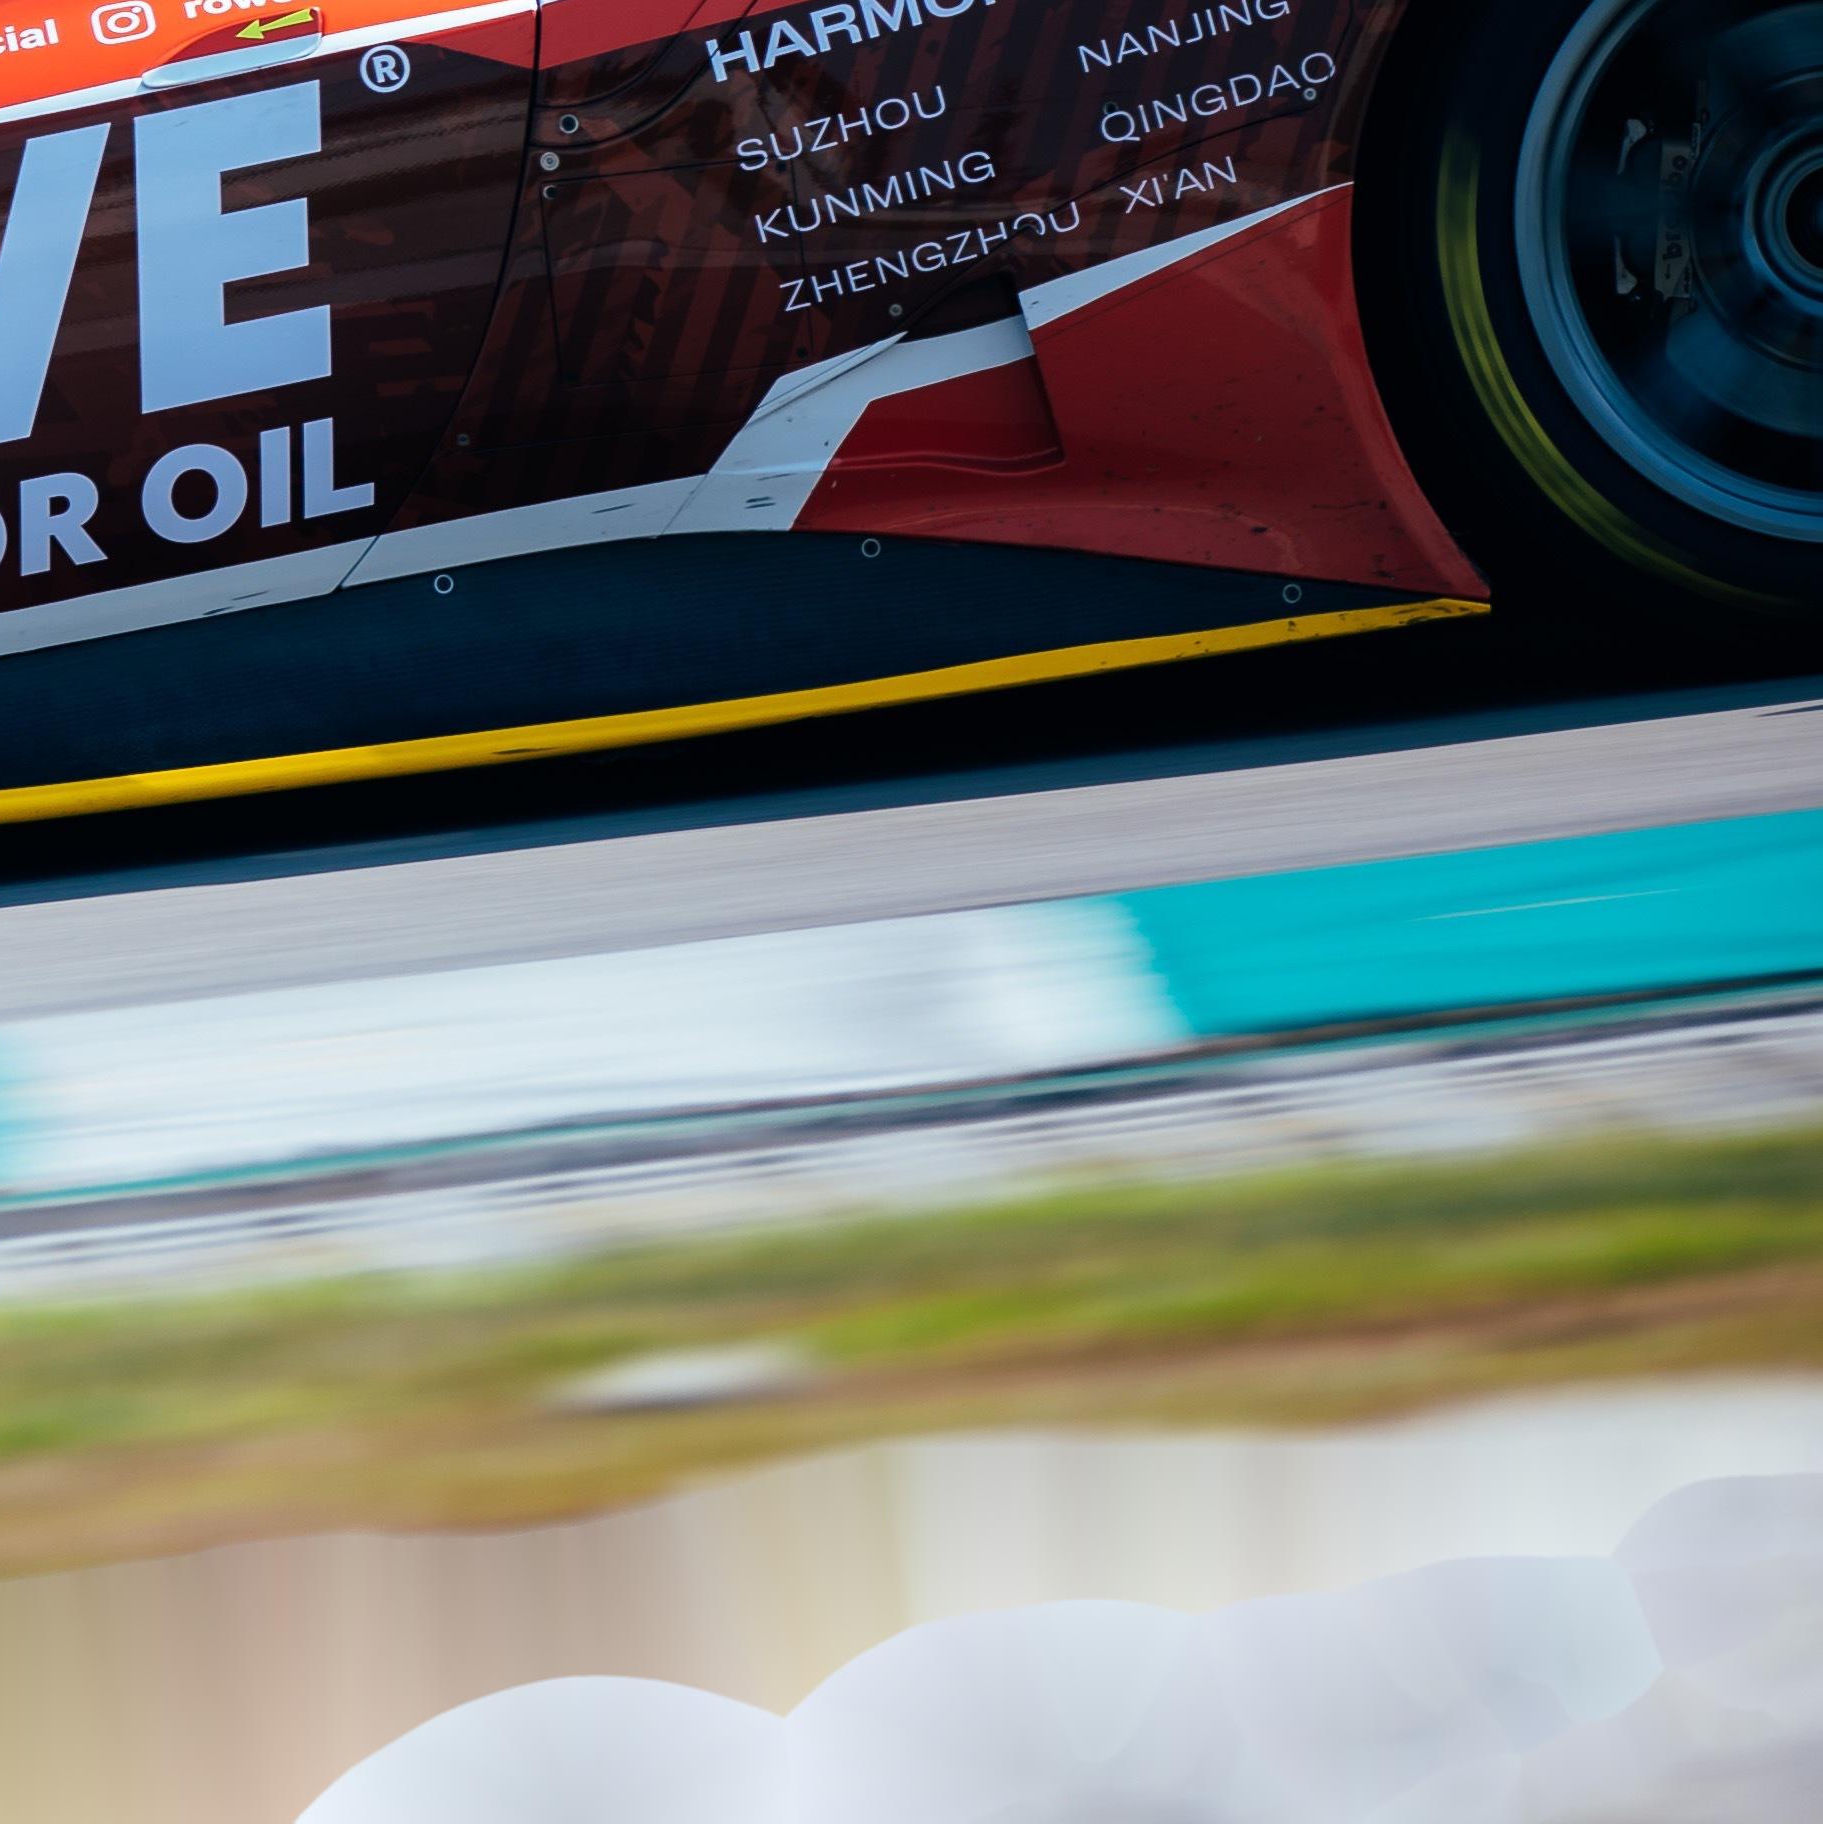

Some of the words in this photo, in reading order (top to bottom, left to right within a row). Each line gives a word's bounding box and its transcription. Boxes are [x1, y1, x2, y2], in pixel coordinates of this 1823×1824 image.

[735, 85, 947, 172] SUZHOU
[1100, 51, 1337, 143] QINGDAO
[754, 150, 996, 244] KUNMING
[1118, 155, 1238, 214] XI'AN
[140, 415, 376, 544] OIL
